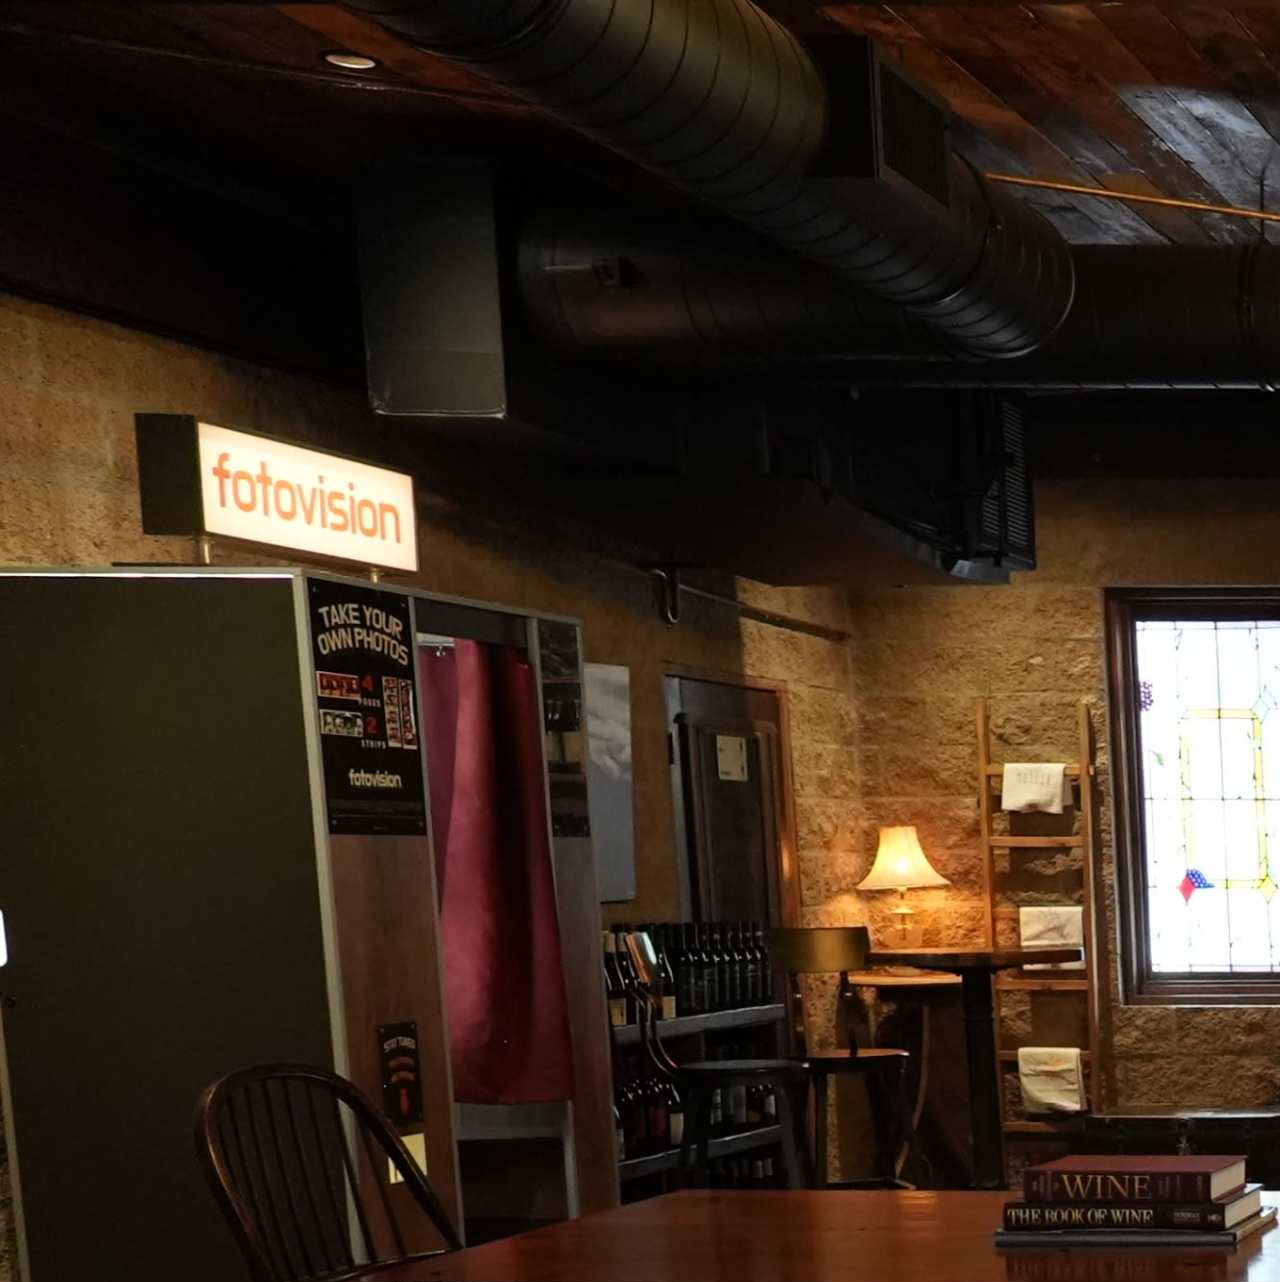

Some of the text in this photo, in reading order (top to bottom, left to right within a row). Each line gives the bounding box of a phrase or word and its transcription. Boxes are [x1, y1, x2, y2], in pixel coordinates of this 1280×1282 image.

[212, 452, 401, 544] fotovision
[318, 603, 403, 641] TAKE YOUR
[317, 627, 408, 666] OWN PHOTOS
[361, 675, 373, 691] 4
[366, 715, 377, 734] 2
[361, 739, 386, 750] STRIPS
[348, 768, 402, 788] fotovision
[1061, 1174, 1153, 1199] WINE
[1007, 1208, 1043, 1225] THE
[1045, 1208, 1087, 1225] BOOK
[1087, 1208, 1107, 1225] OF
[1110, 1208, 1154, 1225] WINE
